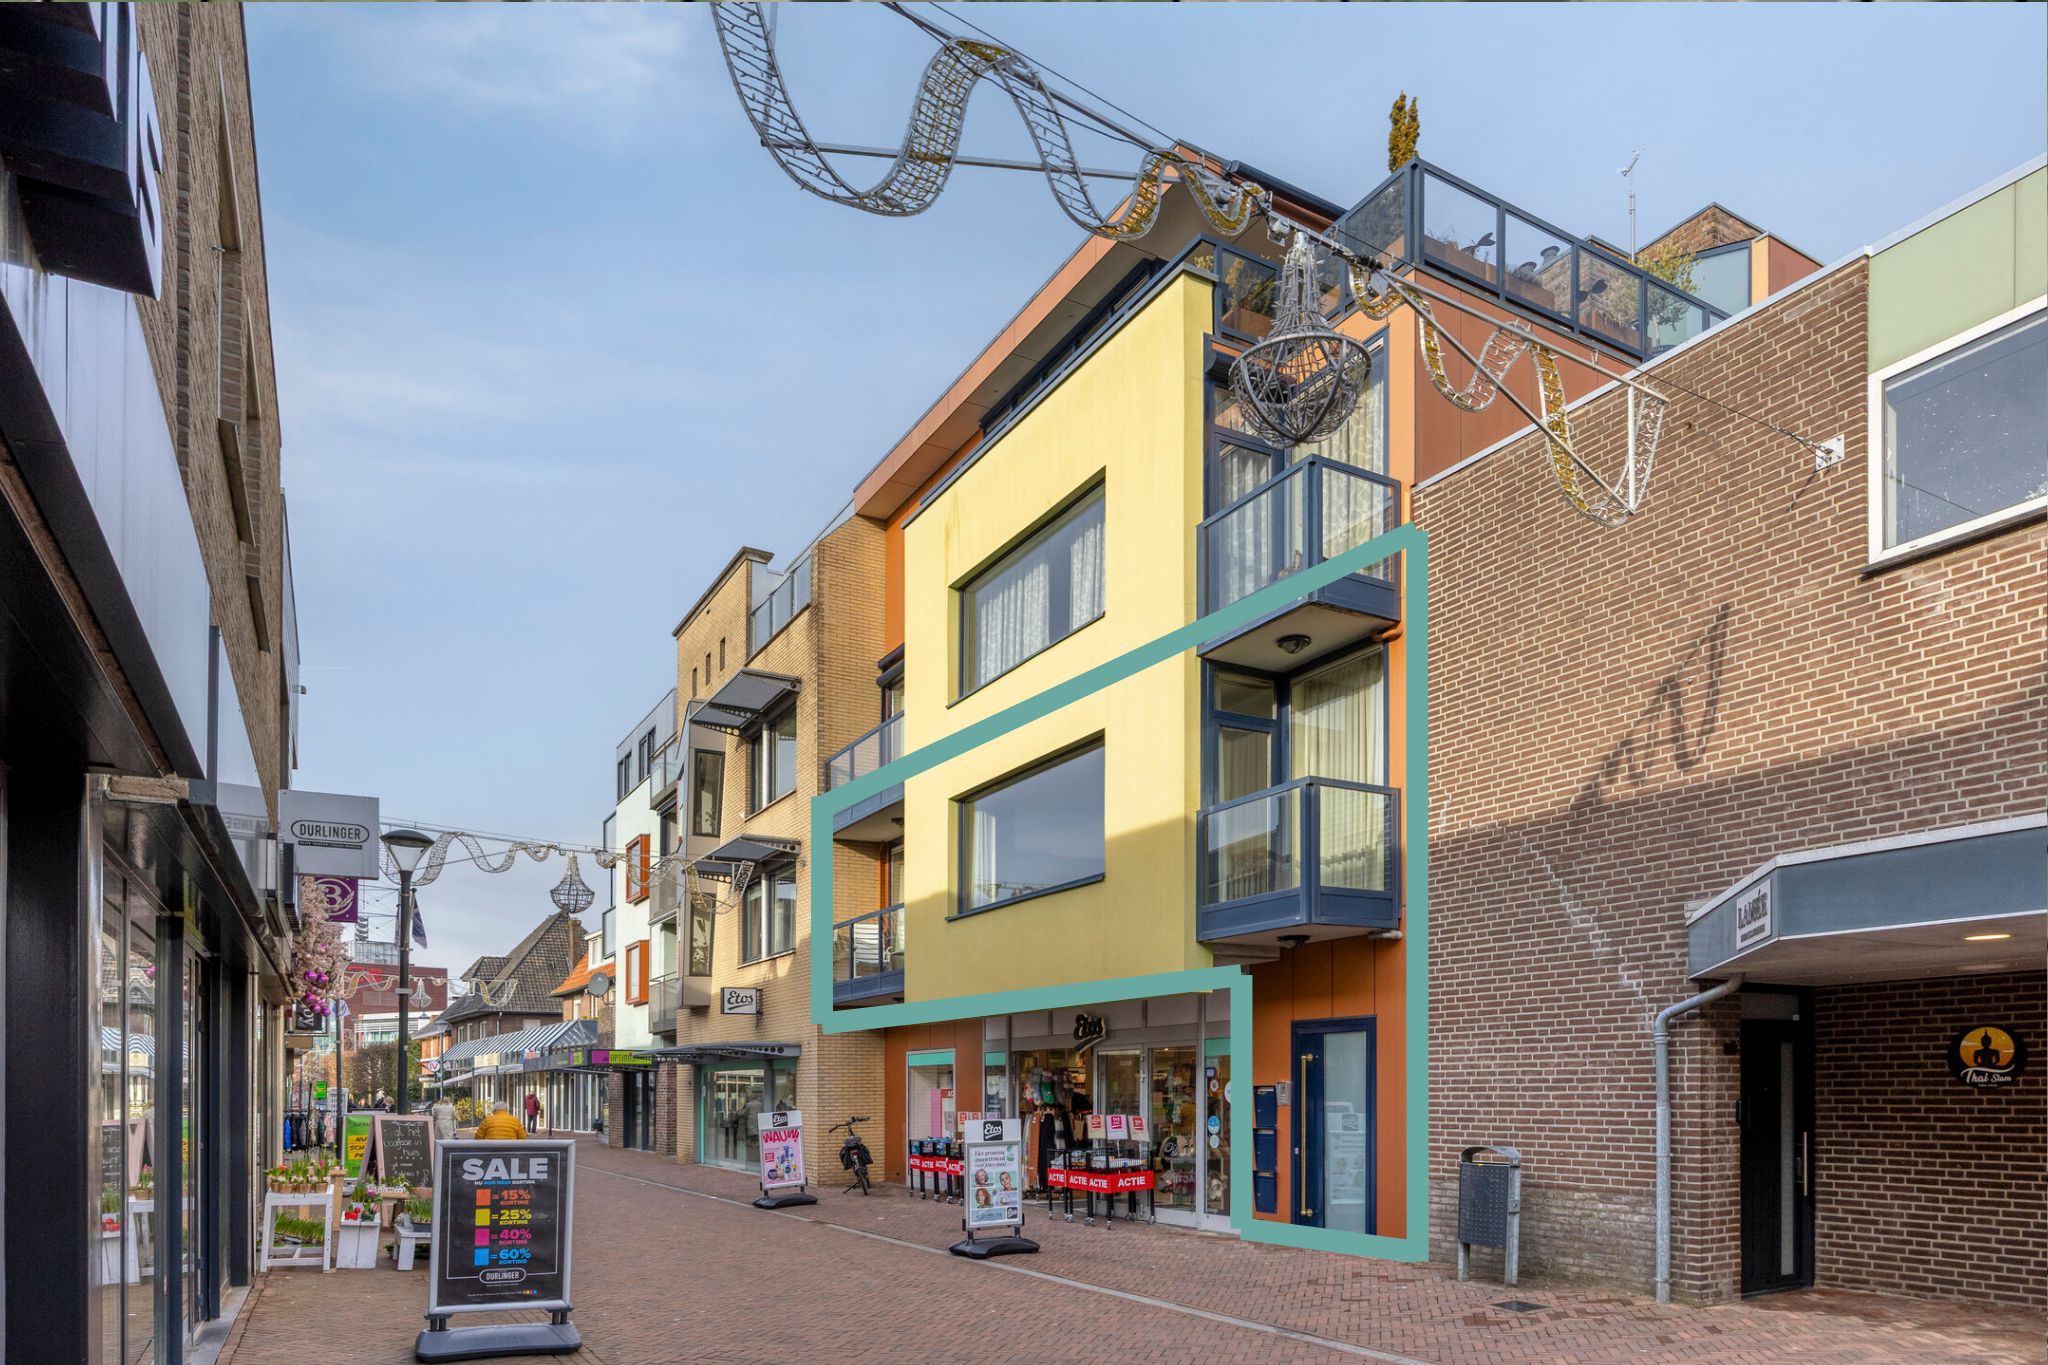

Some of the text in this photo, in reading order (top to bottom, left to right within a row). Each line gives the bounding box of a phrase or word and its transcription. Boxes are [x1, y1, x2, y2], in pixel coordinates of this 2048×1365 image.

[300, 823, 361, 840] DURLINGER
[727, 990, 754, 1005] Etos
[1073, 1013, 1106, 1041] Etos
[1961, 1068, 2012, 1083] Thai Siam
[773, 1114, 787, 1123] Etos
[984, 1123, 1002, 1135] Etos
[763, 1128, 799, 1143] WAUW!
[462, 1157, 548, 1180] SALE
[1048, 1173, 1065, 1183] ACTIE
[1069, 1175, 1146, 1188] ACTIE ACTIE ACTIE
[501, 1189, 530, 1200] 15%
[500, 1209, 532, 1220] 25%
[499, 1228, 532, 1240] 40%
[498, 1248, 532, 1260] 60%
[486, 1271, 520, 1280] DURLINGER
